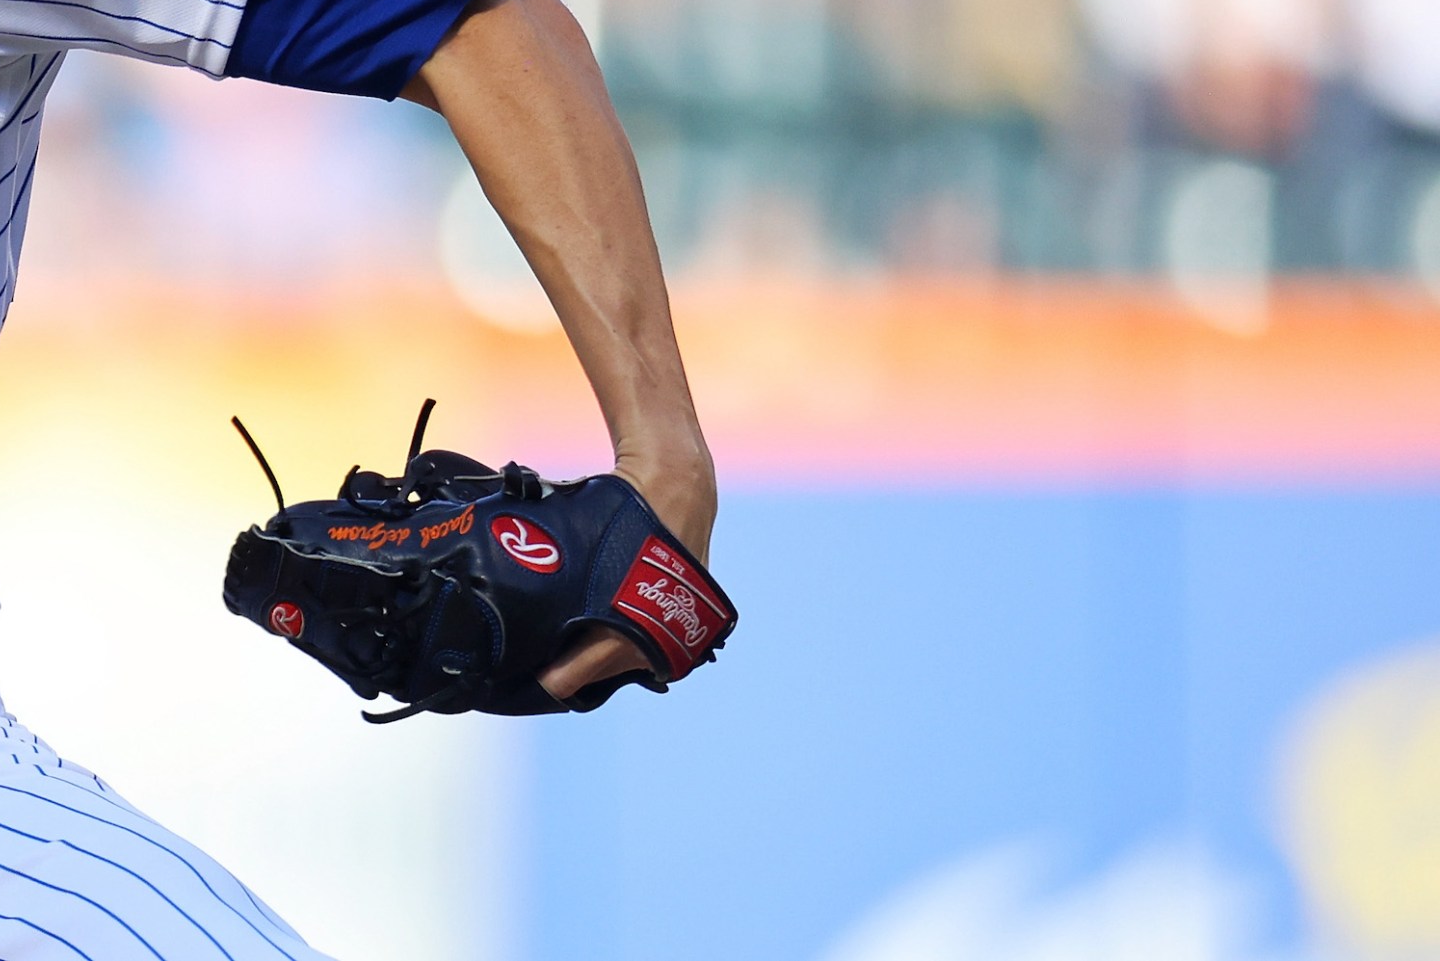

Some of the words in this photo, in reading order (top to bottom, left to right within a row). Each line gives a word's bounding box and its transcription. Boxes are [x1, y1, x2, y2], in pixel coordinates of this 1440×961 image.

[327, 522, 411, 551] deGrom
[419, 504, 476, 549] Jacob
[500, 518, 559, 566] R
[271, 606, 299, 638] R
[635, 578, 708, 647] Rawlings
